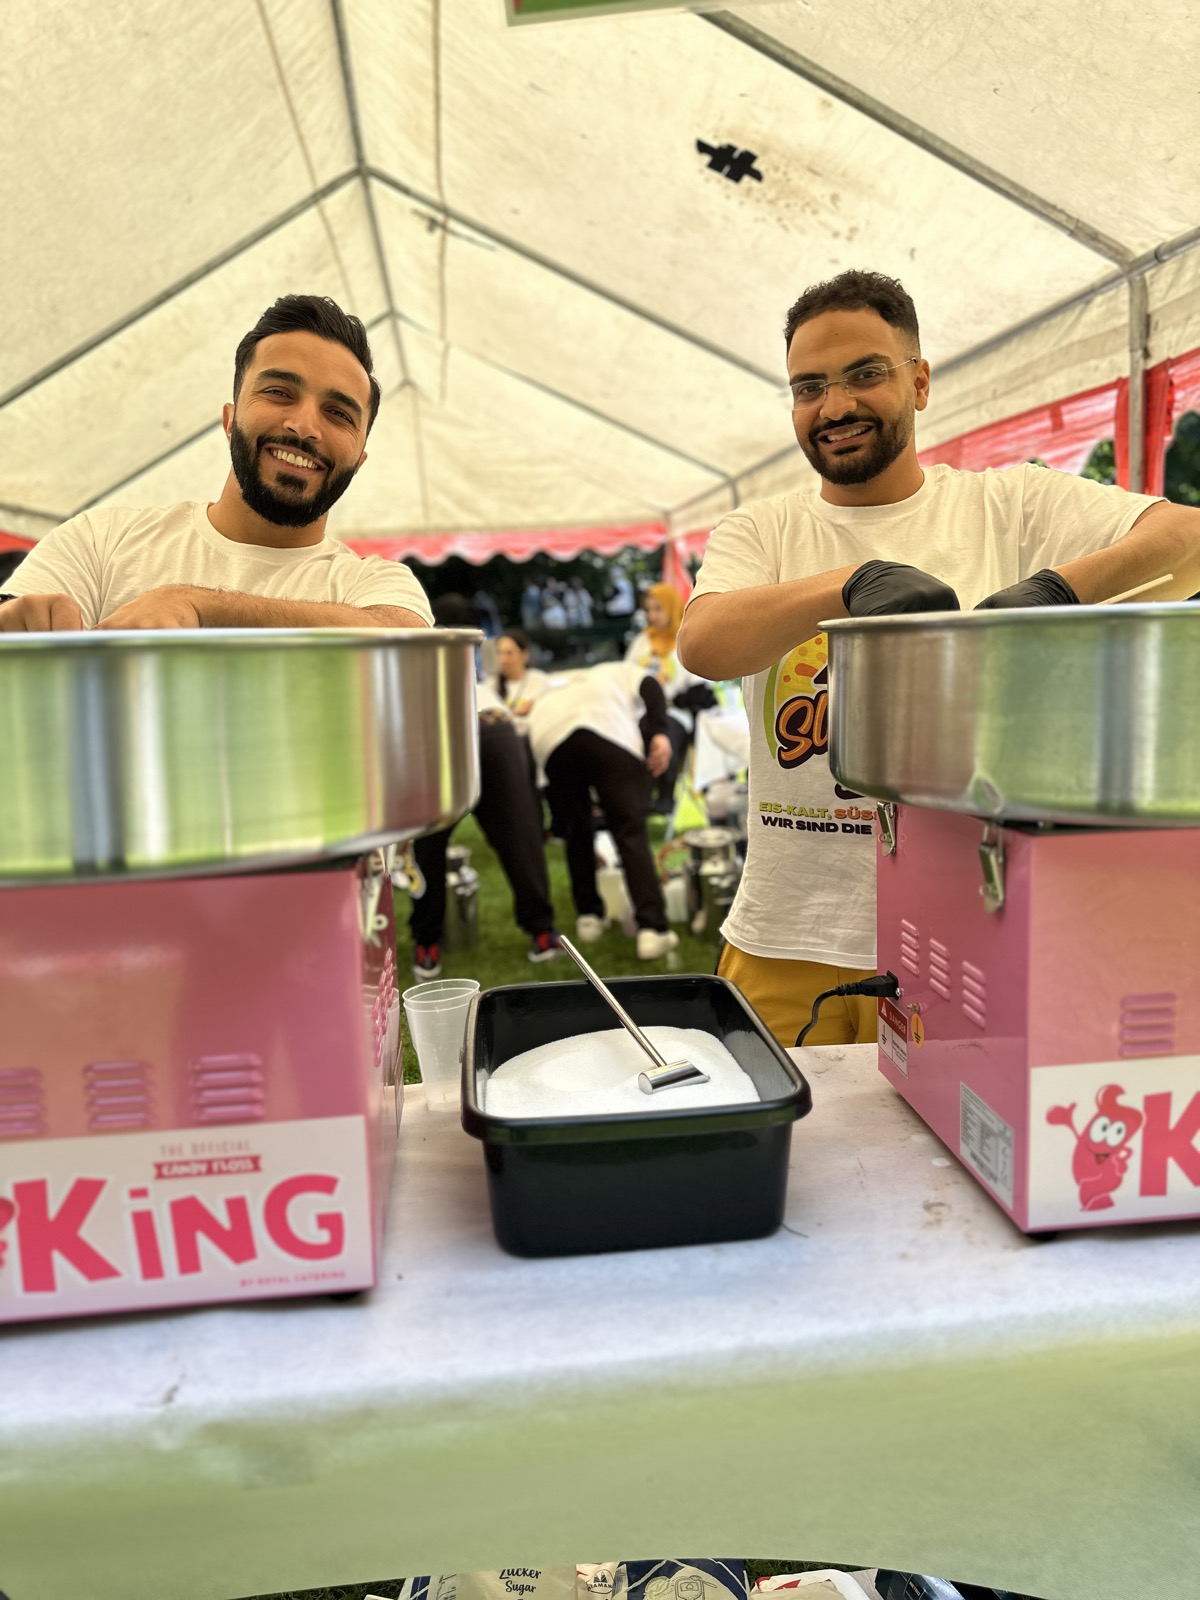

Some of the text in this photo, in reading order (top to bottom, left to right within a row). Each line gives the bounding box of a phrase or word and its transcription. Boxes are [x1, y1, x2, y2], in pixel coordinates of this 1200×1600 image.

[759, 802, 832, 820] EIS-KALT,
[761, 815, 872, 834] WIR SIND DIE
[191, 1139, 251, 1155] OFFICIAL
[161, 1158, 255, 1177] CANDY FLOSS
[505, 1580, 536, 1596] Sugar
